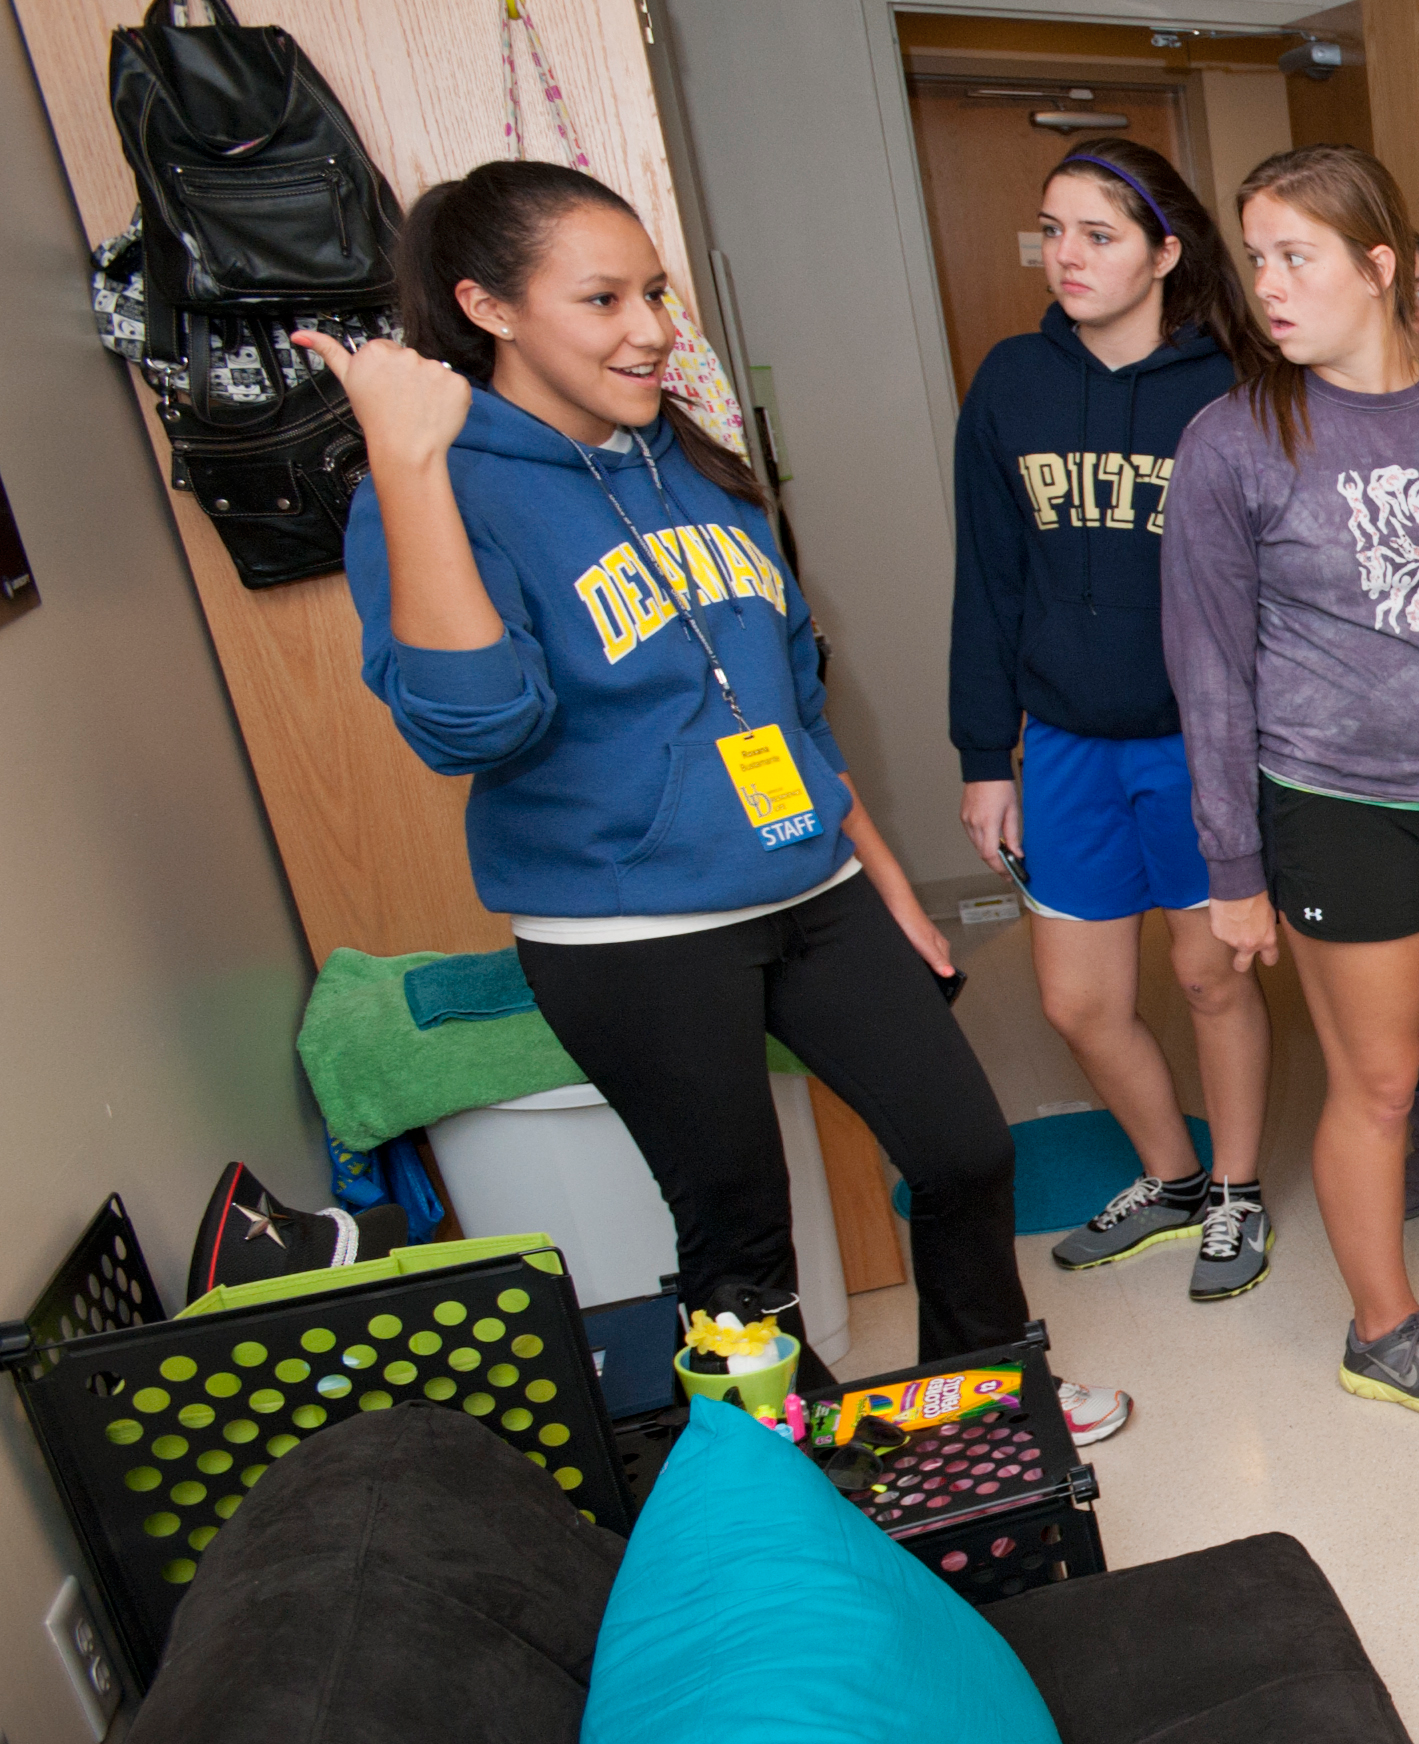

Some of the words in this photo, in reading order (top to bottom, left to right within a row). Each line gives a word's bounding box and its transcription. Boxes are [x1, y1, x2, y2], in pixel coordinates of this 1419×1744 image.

[761, 812, 816, 846] STAFF
[924, 1378, 946, 1419] COLORED
[940, 1375, 966, 1414] PENCILS
[979, 1380, 997, 1392] 12
